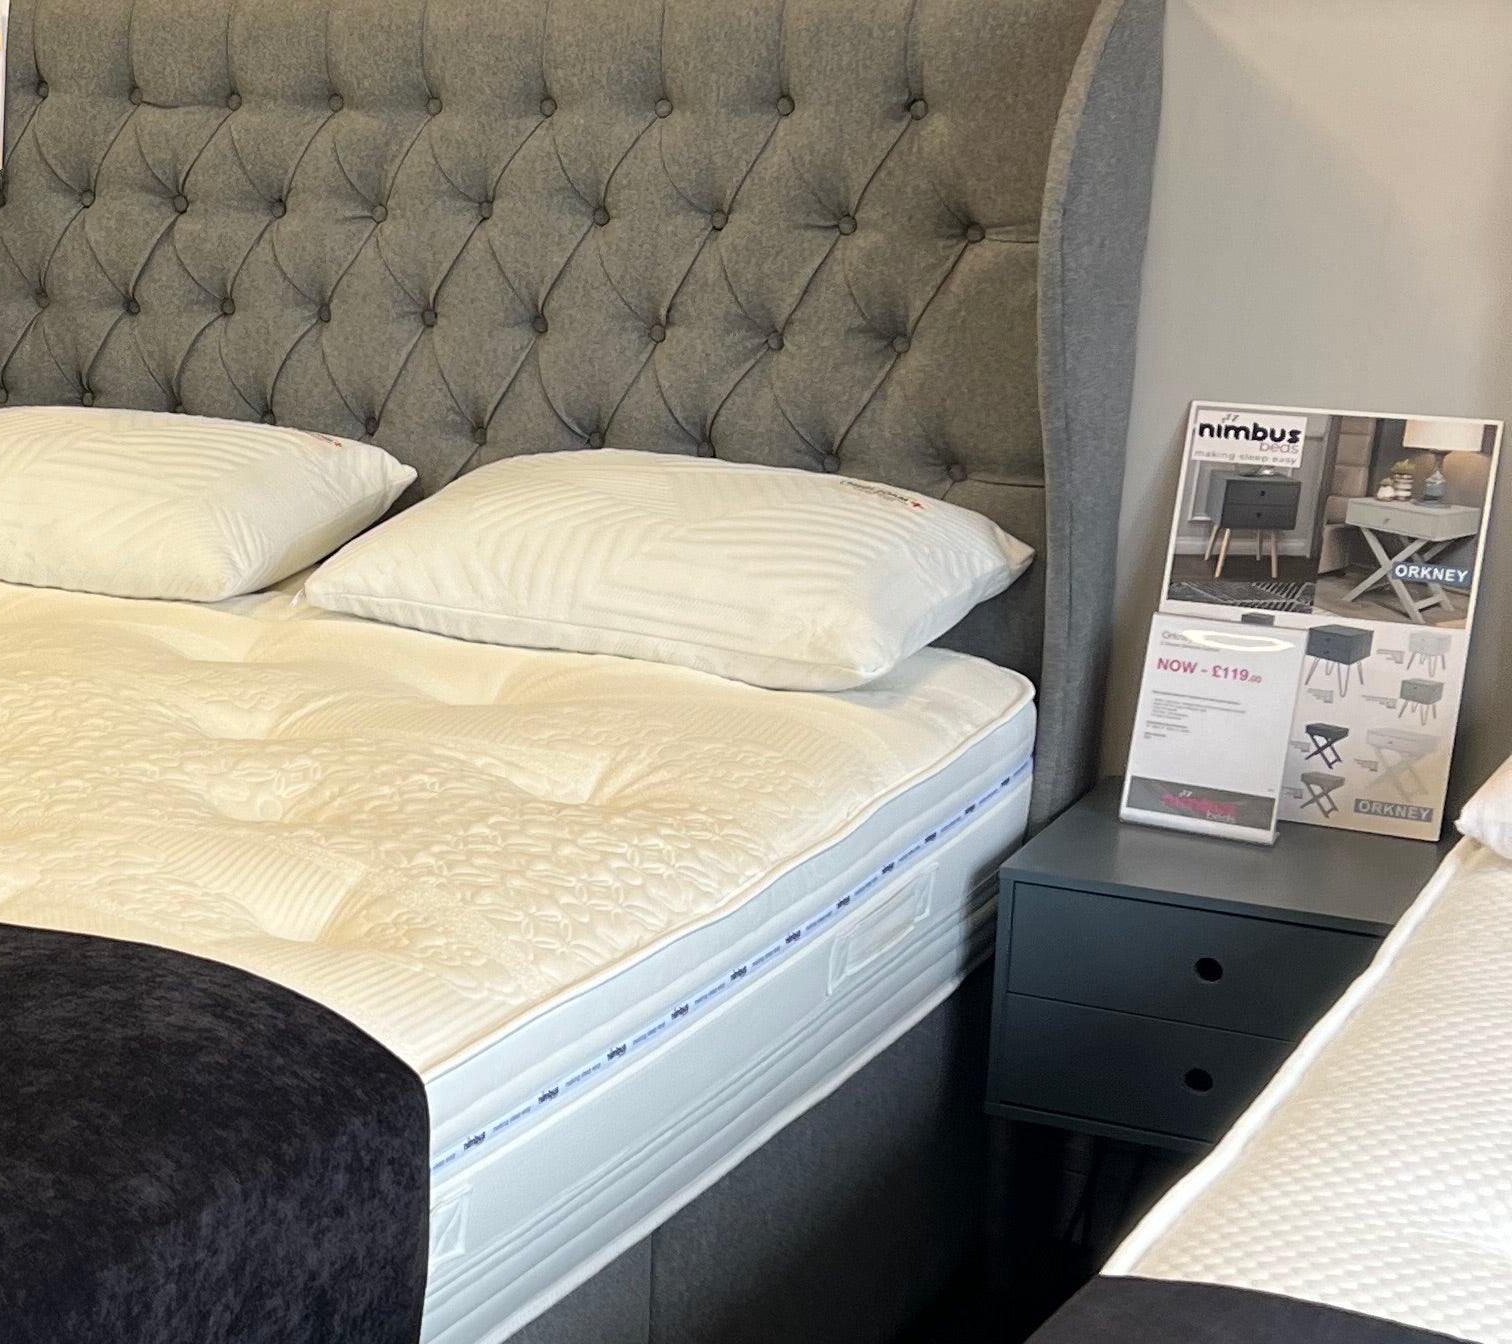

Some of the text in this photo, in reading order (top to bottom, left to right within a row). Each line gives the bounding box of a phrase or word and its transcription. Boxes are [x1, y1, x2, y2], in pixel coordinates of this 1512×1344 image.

[1199, 422, 1302, 444] nimbus
[1195, 450, 1235, 461] making
[1272, 456, 1297, 464] easy
[1259, 442, 1299, 454] beds
[1395, 564, 1468, 583] ORKNEY
[1157, 657, 1197, 674] NOW
[1358, 800, 1431, 821] ORKNEY
